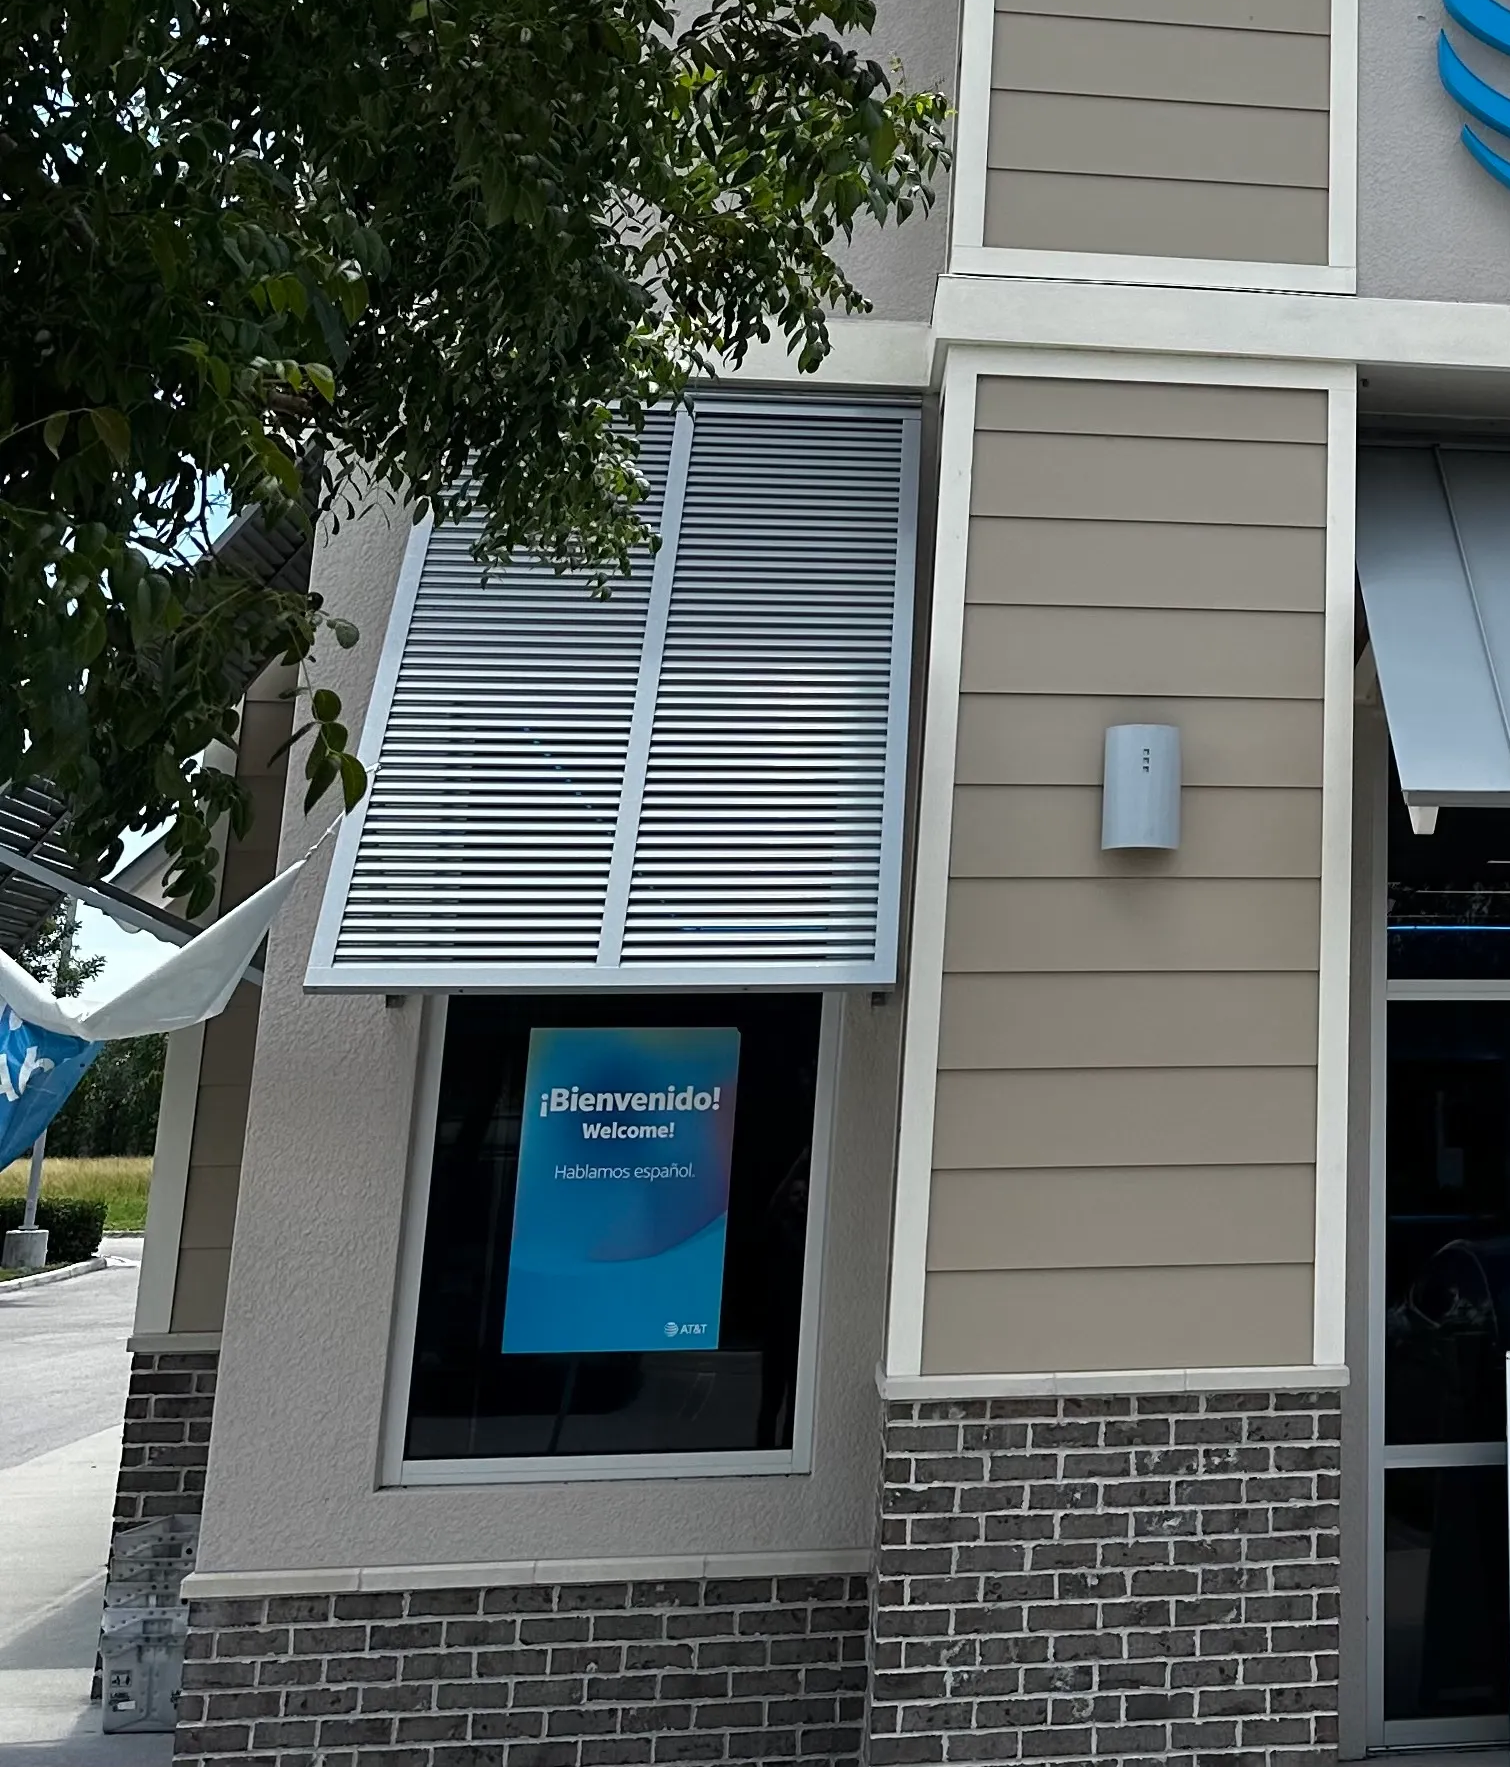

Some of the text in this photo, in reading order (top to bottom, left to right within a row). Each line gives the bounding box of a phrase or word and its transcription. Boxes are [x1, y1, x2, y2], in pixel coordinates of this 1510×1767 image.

[540, 1085, 721, 1117] ¡Bienvenido!
[582, 1122, 675, 1139] Welcome!
[554, 1163, 695, 1181] Hablamos español.
[680, 1324, 707, 1334] AT&T
